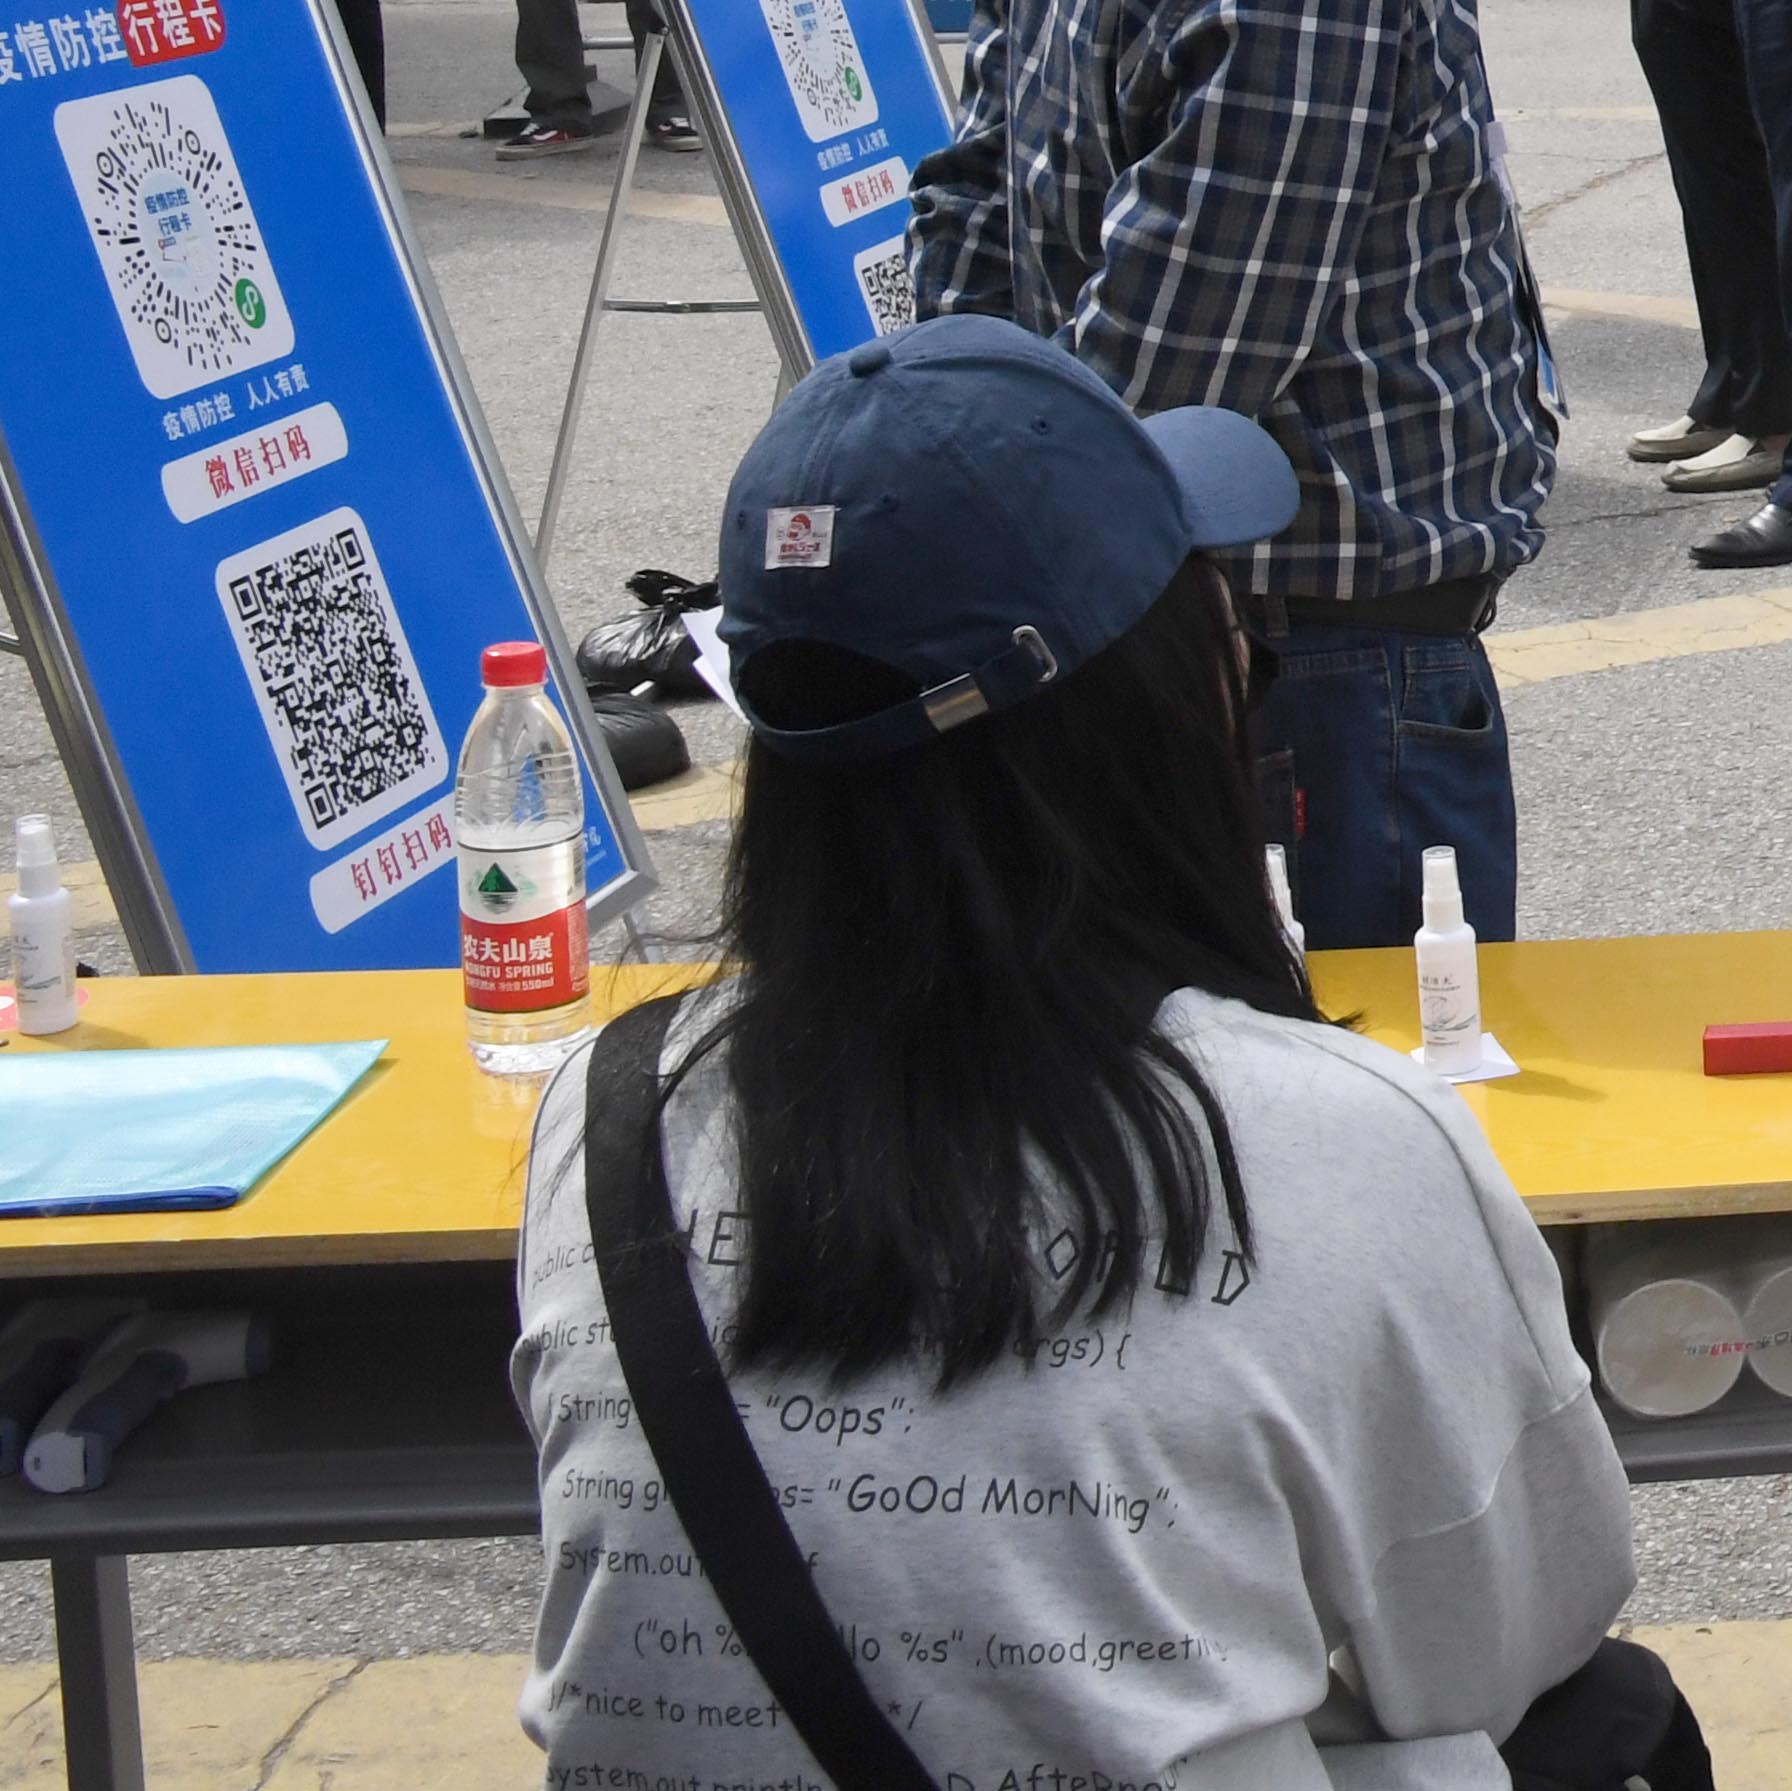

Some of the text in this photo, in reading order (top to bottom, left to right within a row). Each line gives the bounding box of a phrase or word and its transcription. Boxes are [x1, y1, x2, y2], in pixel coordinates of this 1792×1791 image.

[840, 168, 896, 215] 微信扫码
[162, 363, 311, 443] 疫情防控 人人有责
[205, 423, 313, 500] 微信扫码
[350, 812, 452, 902] 钉钉扫码
[463, 933, 555, 964] 农夫山泉
[505, 961, 554, 979] SPRING
[561, 1468, 634, 1511] String
[655, 1695, 686, 1724] to
[697, 1701, 780, 1729] meet
